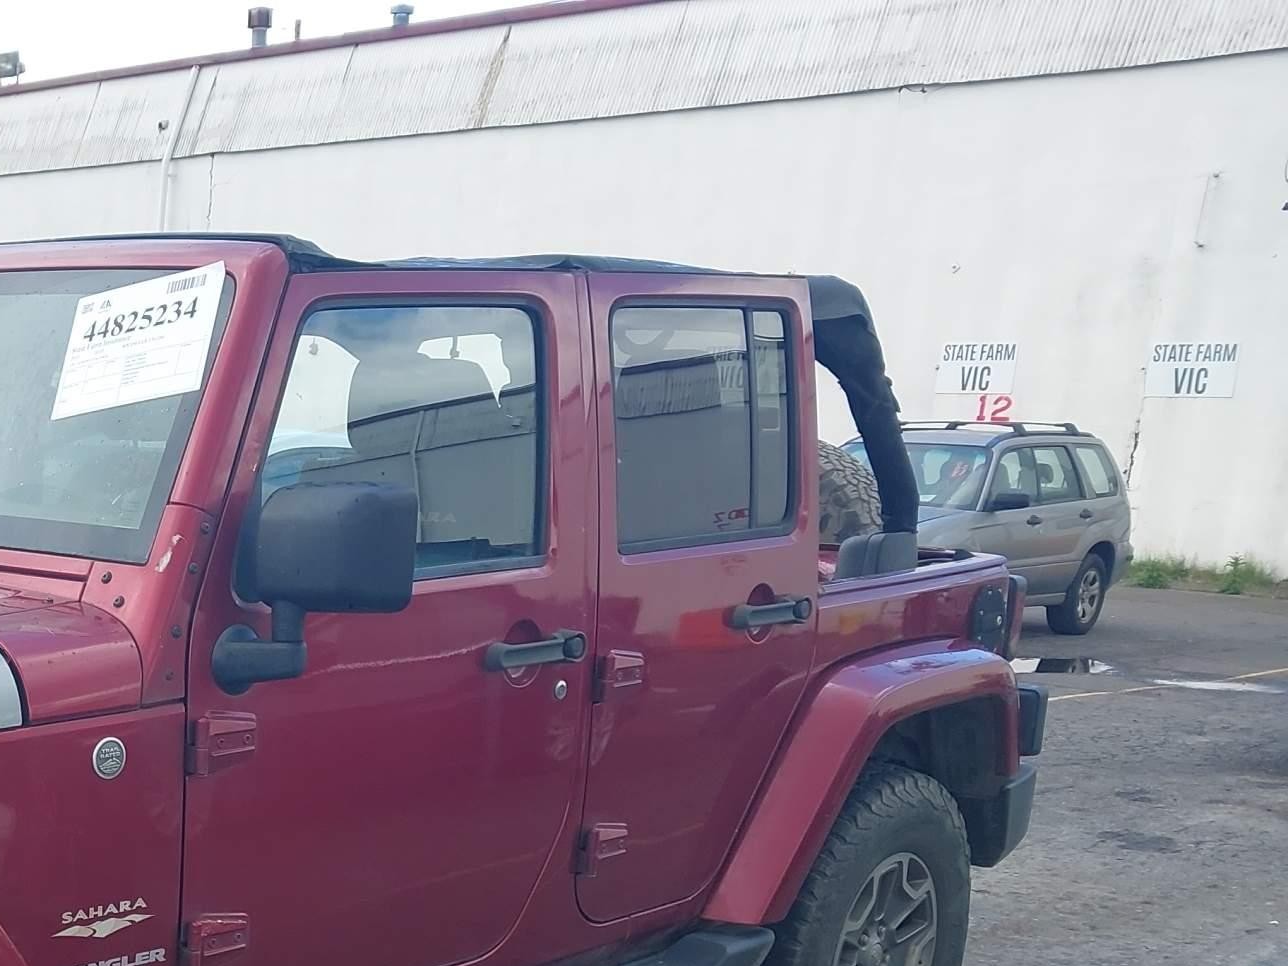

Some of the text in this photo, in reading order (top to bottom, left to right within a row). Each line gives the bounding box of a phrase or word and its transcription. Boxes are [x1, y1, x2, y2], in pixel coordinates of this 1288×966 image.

[83, 296, 198, 342] 44825234
[943, 344, 1016, 361] STATE FARM
[1153, 344, 1237, 362] STATE FARM
[961, 366, 991, 391] VIC
[1174, 367, 1208, 394] VIC
[976, 395, 1012, 421] 12
[62, 898, 147, 924] SAHARA
